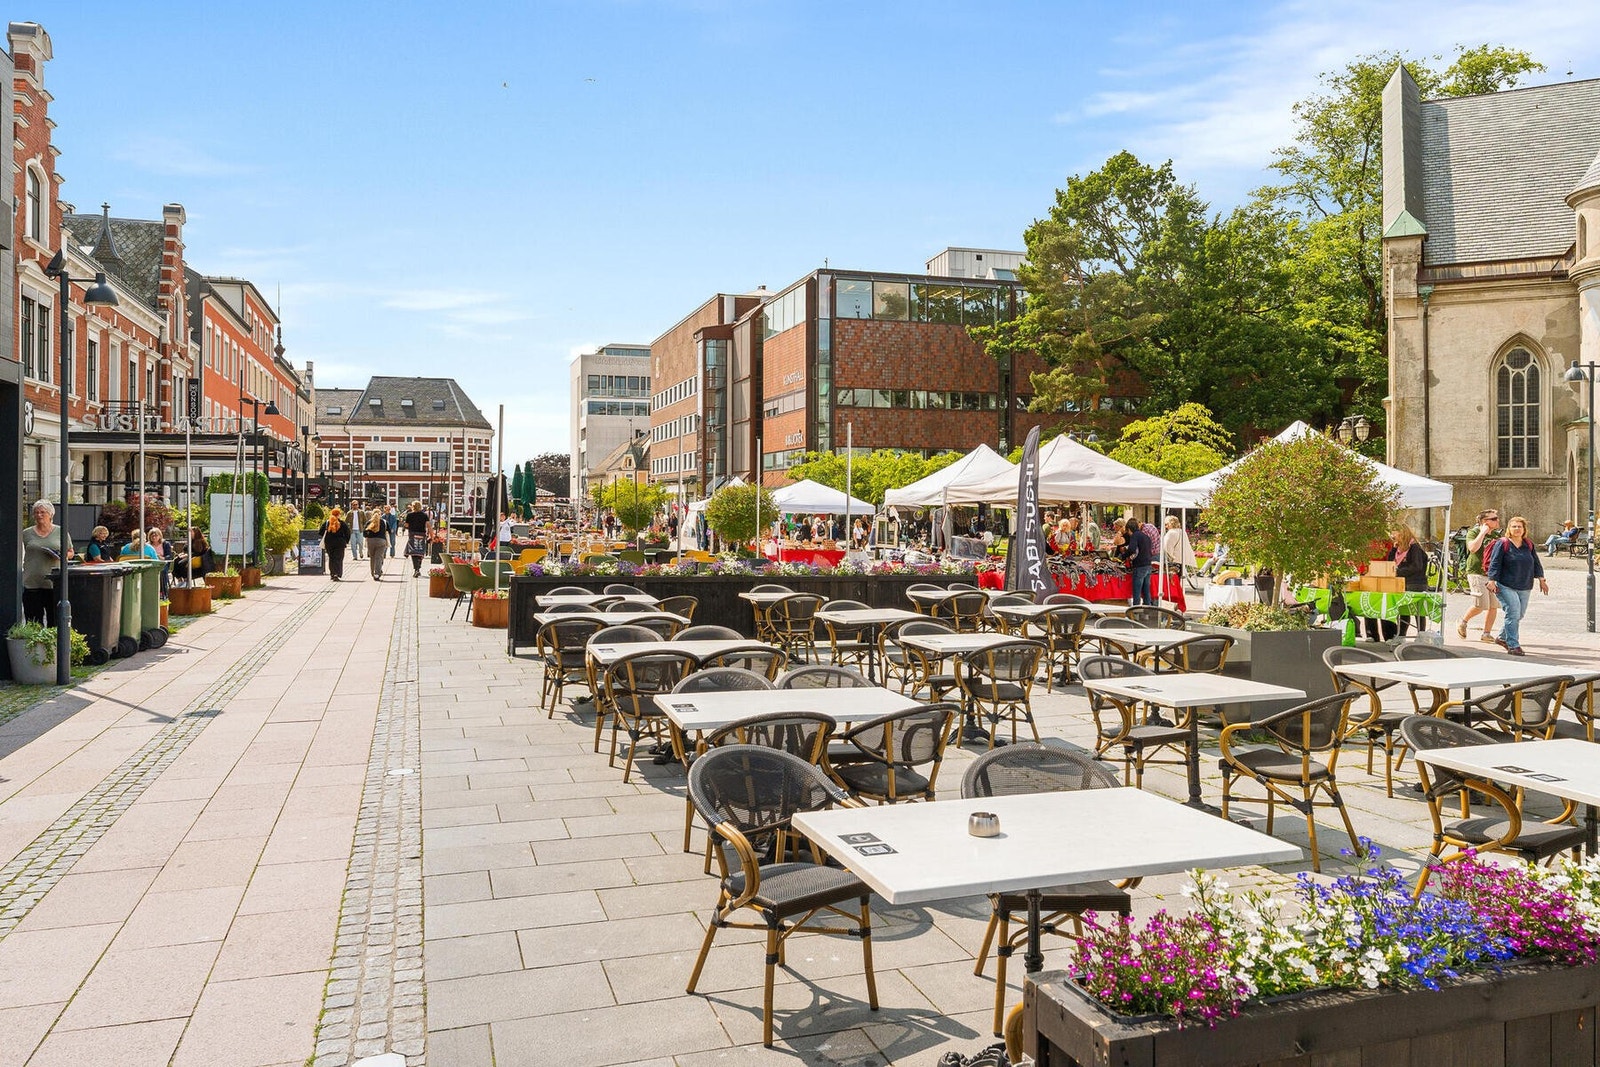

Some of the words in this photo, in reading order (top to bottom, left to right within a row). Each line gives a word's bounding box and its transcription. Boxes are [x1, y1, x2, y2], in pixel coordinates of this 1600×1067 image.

[81, 413, 163, 433] SUSHI
[1026, 464, 1036, 533] SUSHI
[1026, 538, 1046, 592] SABI
